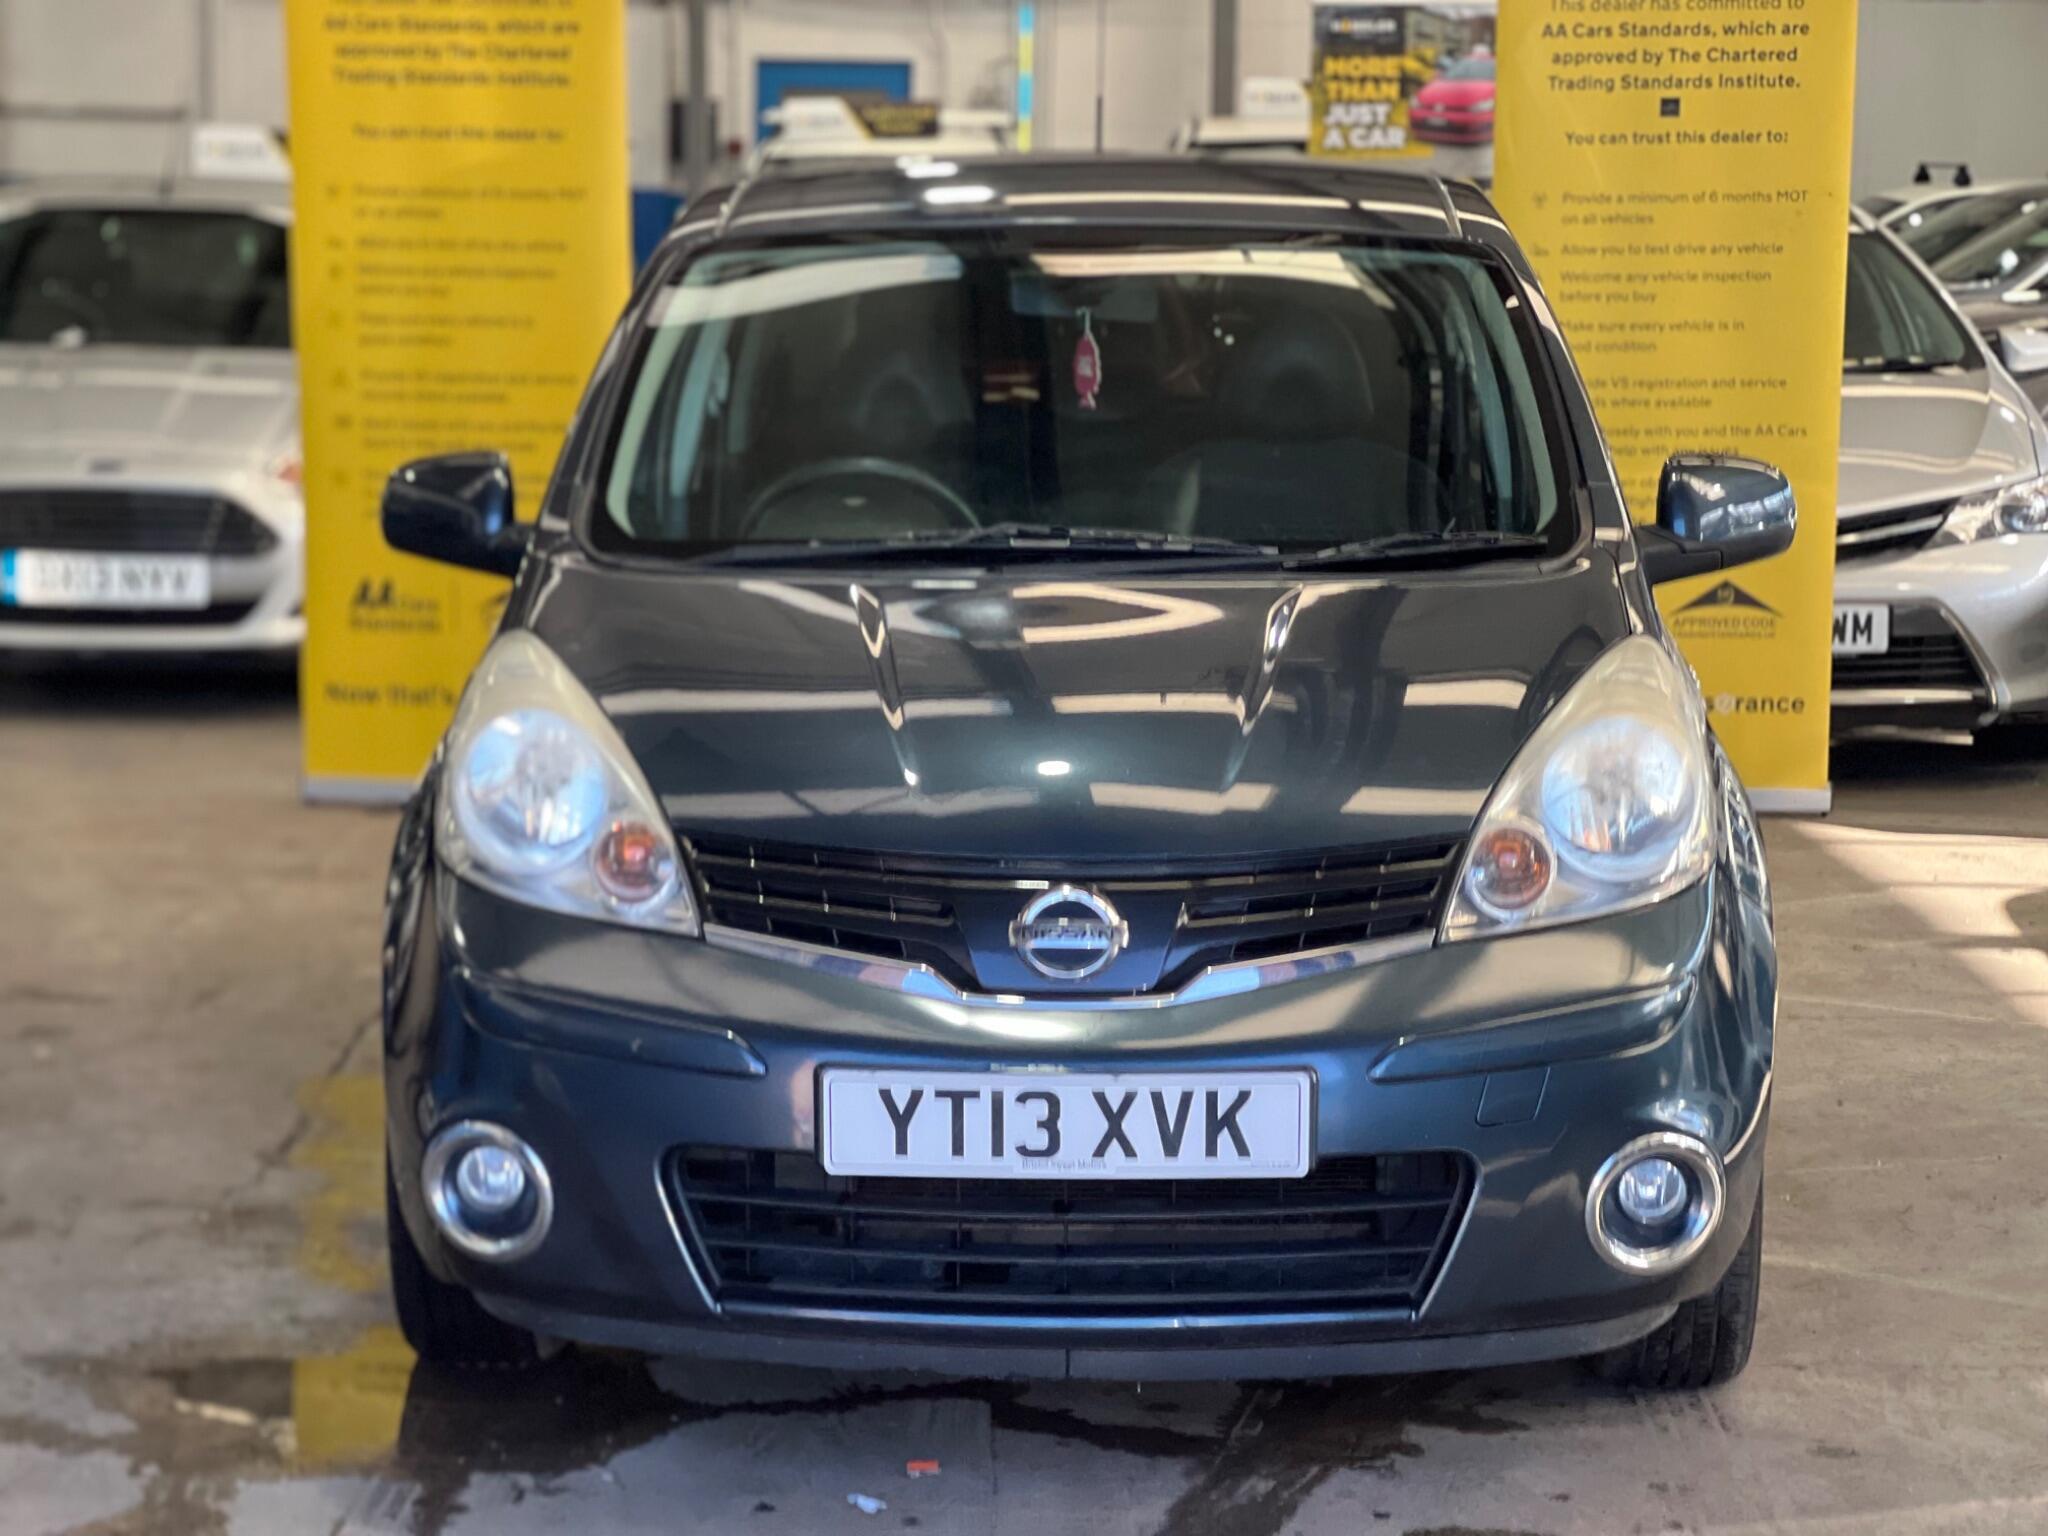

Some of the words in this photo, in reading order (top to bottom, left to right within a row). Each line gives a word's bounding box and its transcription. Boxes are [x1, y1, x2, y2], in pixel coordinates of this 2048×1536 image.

[1551, 0, 1584, 11] This
[1591, 0, 1643, 11] dealer
[1650, 0, 1681, 11] has
[1686, 0, 1781, 10] committed
[1787, 0, 1805, 10] to
[1542, 23, 1567, 38] AA
[1572, 22, 1613, 38] Cars
[1619, 21, 1717, 38] Standards,
[1722, 20, 1776, 36] which
[1781, 23, 1810, 36] are
[1552, 48, 1637, 66] approved
[1642, 48, 1663, 66] by
[1669, 47, 1702, 63] The
[1706, 46, 1798, 62] Chartered
[1324, 55, 1401, 78] MORE
[1326, 79, 1399, 101] THAN
[1548, 74, 1615, 93] Trading
[1621, 73, 1713, 90] Standards
[1718, 72, 1801, 88] Institute.
[1565, 131, 1594, 146] You
[1599, 133, 1628, 145] can
[1632, 131, 1670, 144] trust
[1676, 130, 1706, 144] this
[1711, 129, 1762, 143] dealer
[1767, 130, 1788, 143] to:
[1692, 191, 1706, 203] of
[1722, 191, 1773, 203] months
[1776, 190, 1808, 202] MOT
[1601, 244, 1625, 258] you
[1628, 243, 1641, 254] to
[1673, 242, 1707, 254] drive
[1711, 244, 1733, 257] any
[1737, 241, 1784, 253] vehicle
[1626, 273, 1648, 285] any
[1652, 270, 1699, 282] vehicle
[1702, 269, 1773, 284] inspection
[1632, 289, 1657, 303] buy
[1669, 319, 1715, 331] vehicle
[1732, 318, 1745, 331] in
[1633, 377, 1709, 391] registration
[1711, 376, 1737, 388] and
[1740, 376, 1788, 388] service
[1655, 395, 1712, 408] available
[1702, 425, 1728, 437] and
[1730, 425, 1752, 437] the
[1755, 425, 1774, 437] AA
[1777, 424, 1808, 437] Cars
[877, 1089, 1062, 1158] YT13
[1091, 1090, 1252, 1158] XVK
